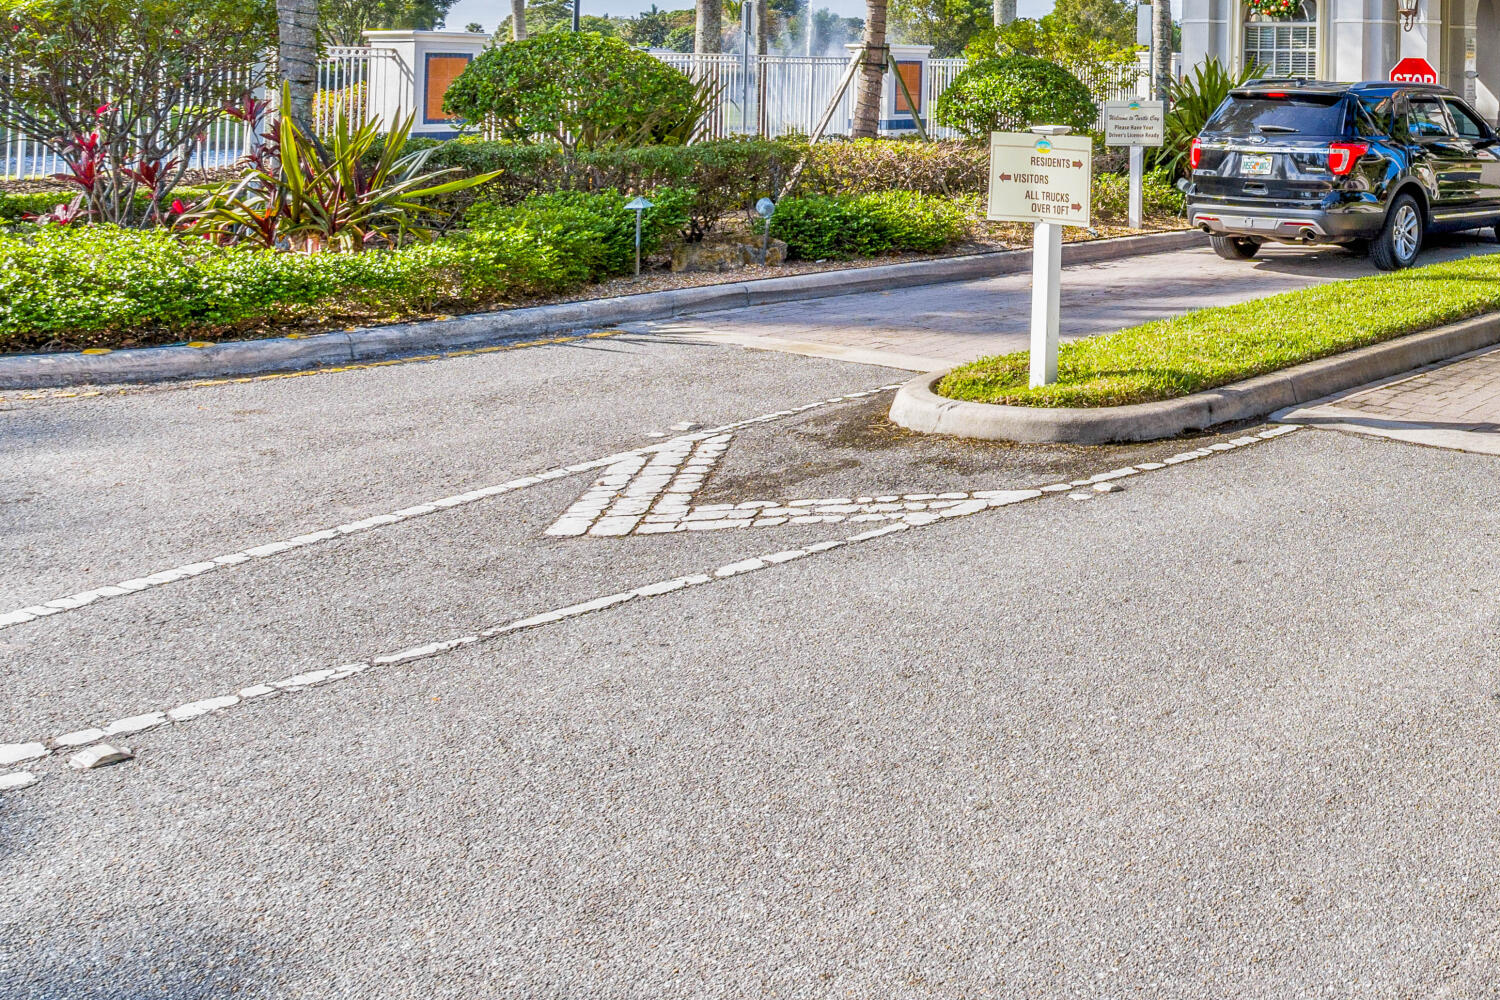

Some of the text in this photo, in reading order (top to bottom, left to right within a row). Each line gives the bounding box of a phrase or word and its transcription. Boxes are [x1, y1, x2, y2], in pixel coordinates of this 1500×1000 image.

[1030, 156, 1071, 168] RESIDENTS
[1013, 173, 1049, 185] VISITORS
[1024, 190, 1070, 203] ALL TRUCKS
[1031, 203, 1069, 215] OVER 10FT
